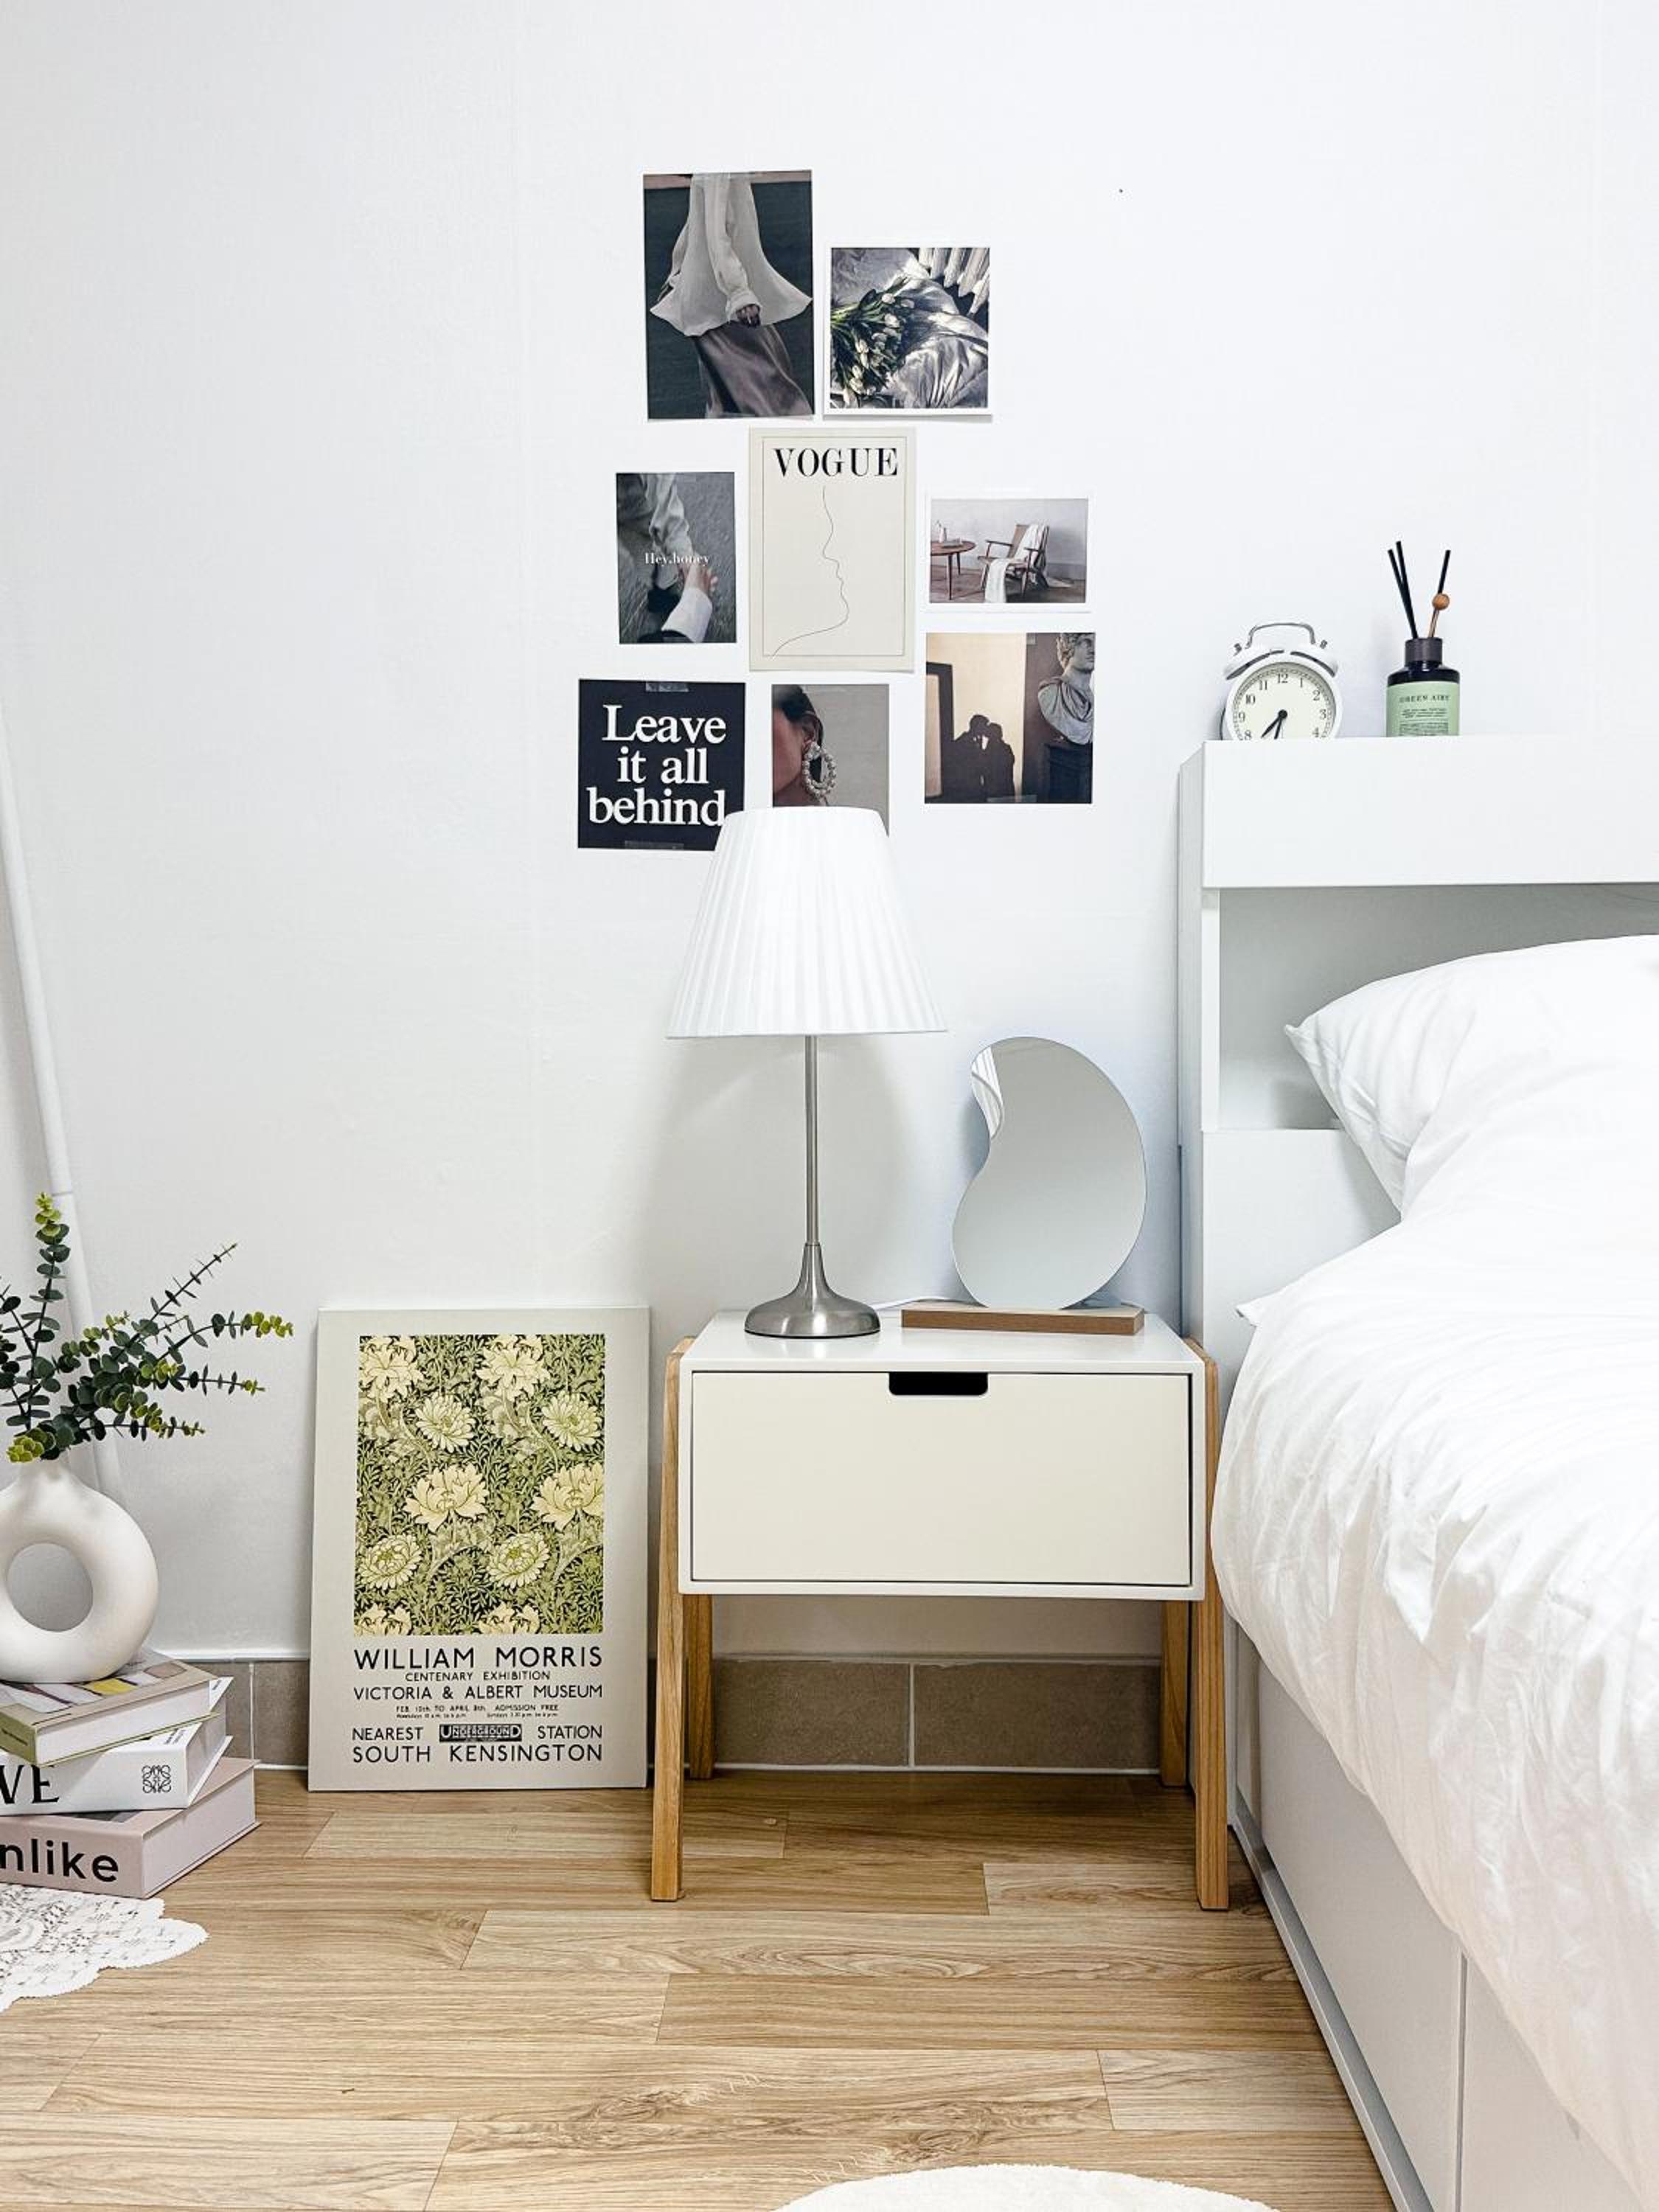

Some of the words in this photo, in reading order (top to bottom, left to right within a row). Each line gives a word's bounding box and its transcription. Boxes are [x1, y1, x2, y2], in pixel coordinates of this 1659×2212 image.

[774, 448, 897, 477] VOGUE
[1259, 680, 1267, 690] 11
[1277, 673, 1288, 684] 12
[1300, 678, 1304, 688] 1
[1245, 693, 1256, 705] 10
[1312, 690, 1321, 701] 2
[1238, 712, 1245, 723] 9
[1320, 709, 1326, 720] 3
[602, 704, 726, 744] Leave
[1244, 729, 1251, 740] 8
[616, 745, 647, 784] it
[660, 747, 709, 785] all
[586, 787, 726, 827] behind
[354, 1647, 474, 1669] WILLIAM
[495, 1646, 602, 1667] MORRIS
[406, 1672, 473, 1682] CENTENARY
[483, 1670, 550, 1680] EXHIBITION
[354, 1686, 432, 1700] VICTORIA
[442, 1686, 453, 1699] &
[465, 1685, 524, 1699] ALBERT
[533, 1685, 602, 1698] MUSEUM
[352, 1727, 424, 1741] NEAREST
[440, 1725, 522, 1739] UNDERGROUND
[538, 1725, 602, 1739] STATION
[353, 1746, 431, 1763] SOUTH
[450, 1745, 602, 1762] KENSINGTON
[0, 1838, 119, 1882] nlike
